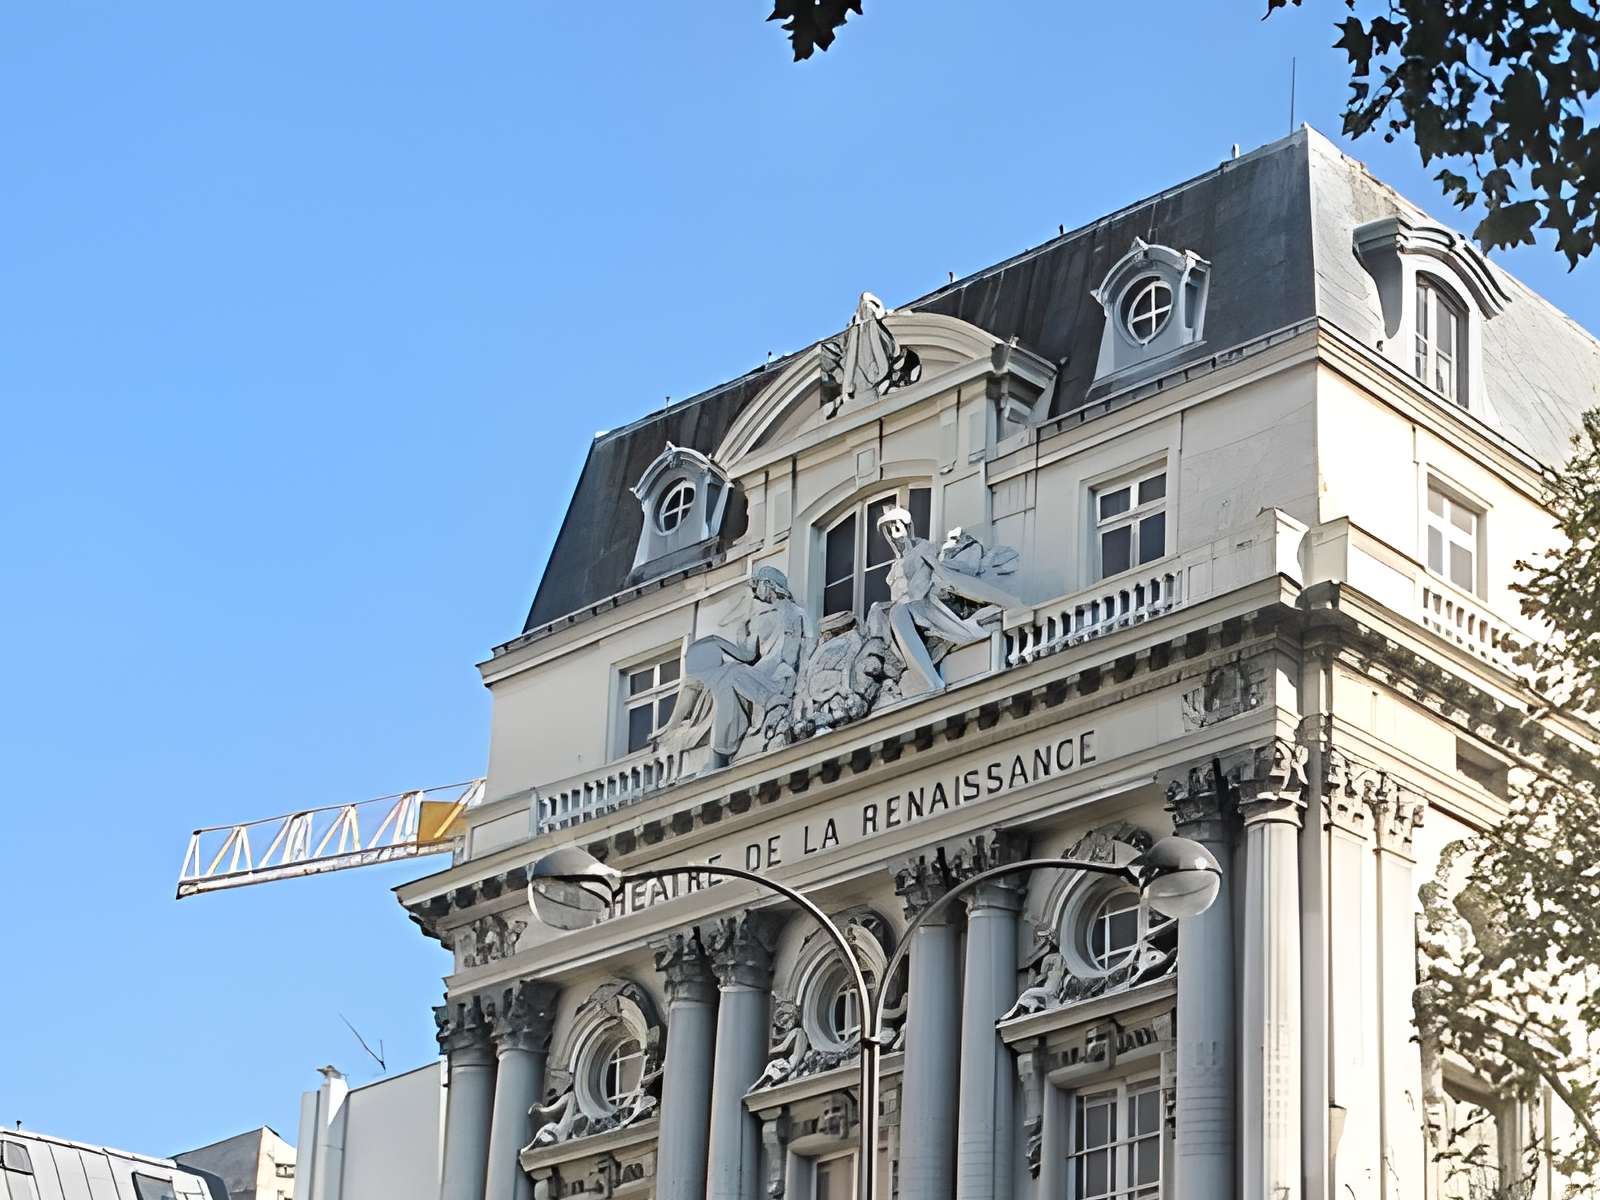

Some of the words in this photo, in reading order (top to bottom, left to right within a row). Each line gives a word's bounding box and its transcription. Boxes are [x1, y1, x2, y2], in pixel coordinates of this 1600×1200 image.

[745, 835, 782, 873] DE
[803, 818, 839, 855] LA
[861, 730, 1097, 837] RENAISSANCE
